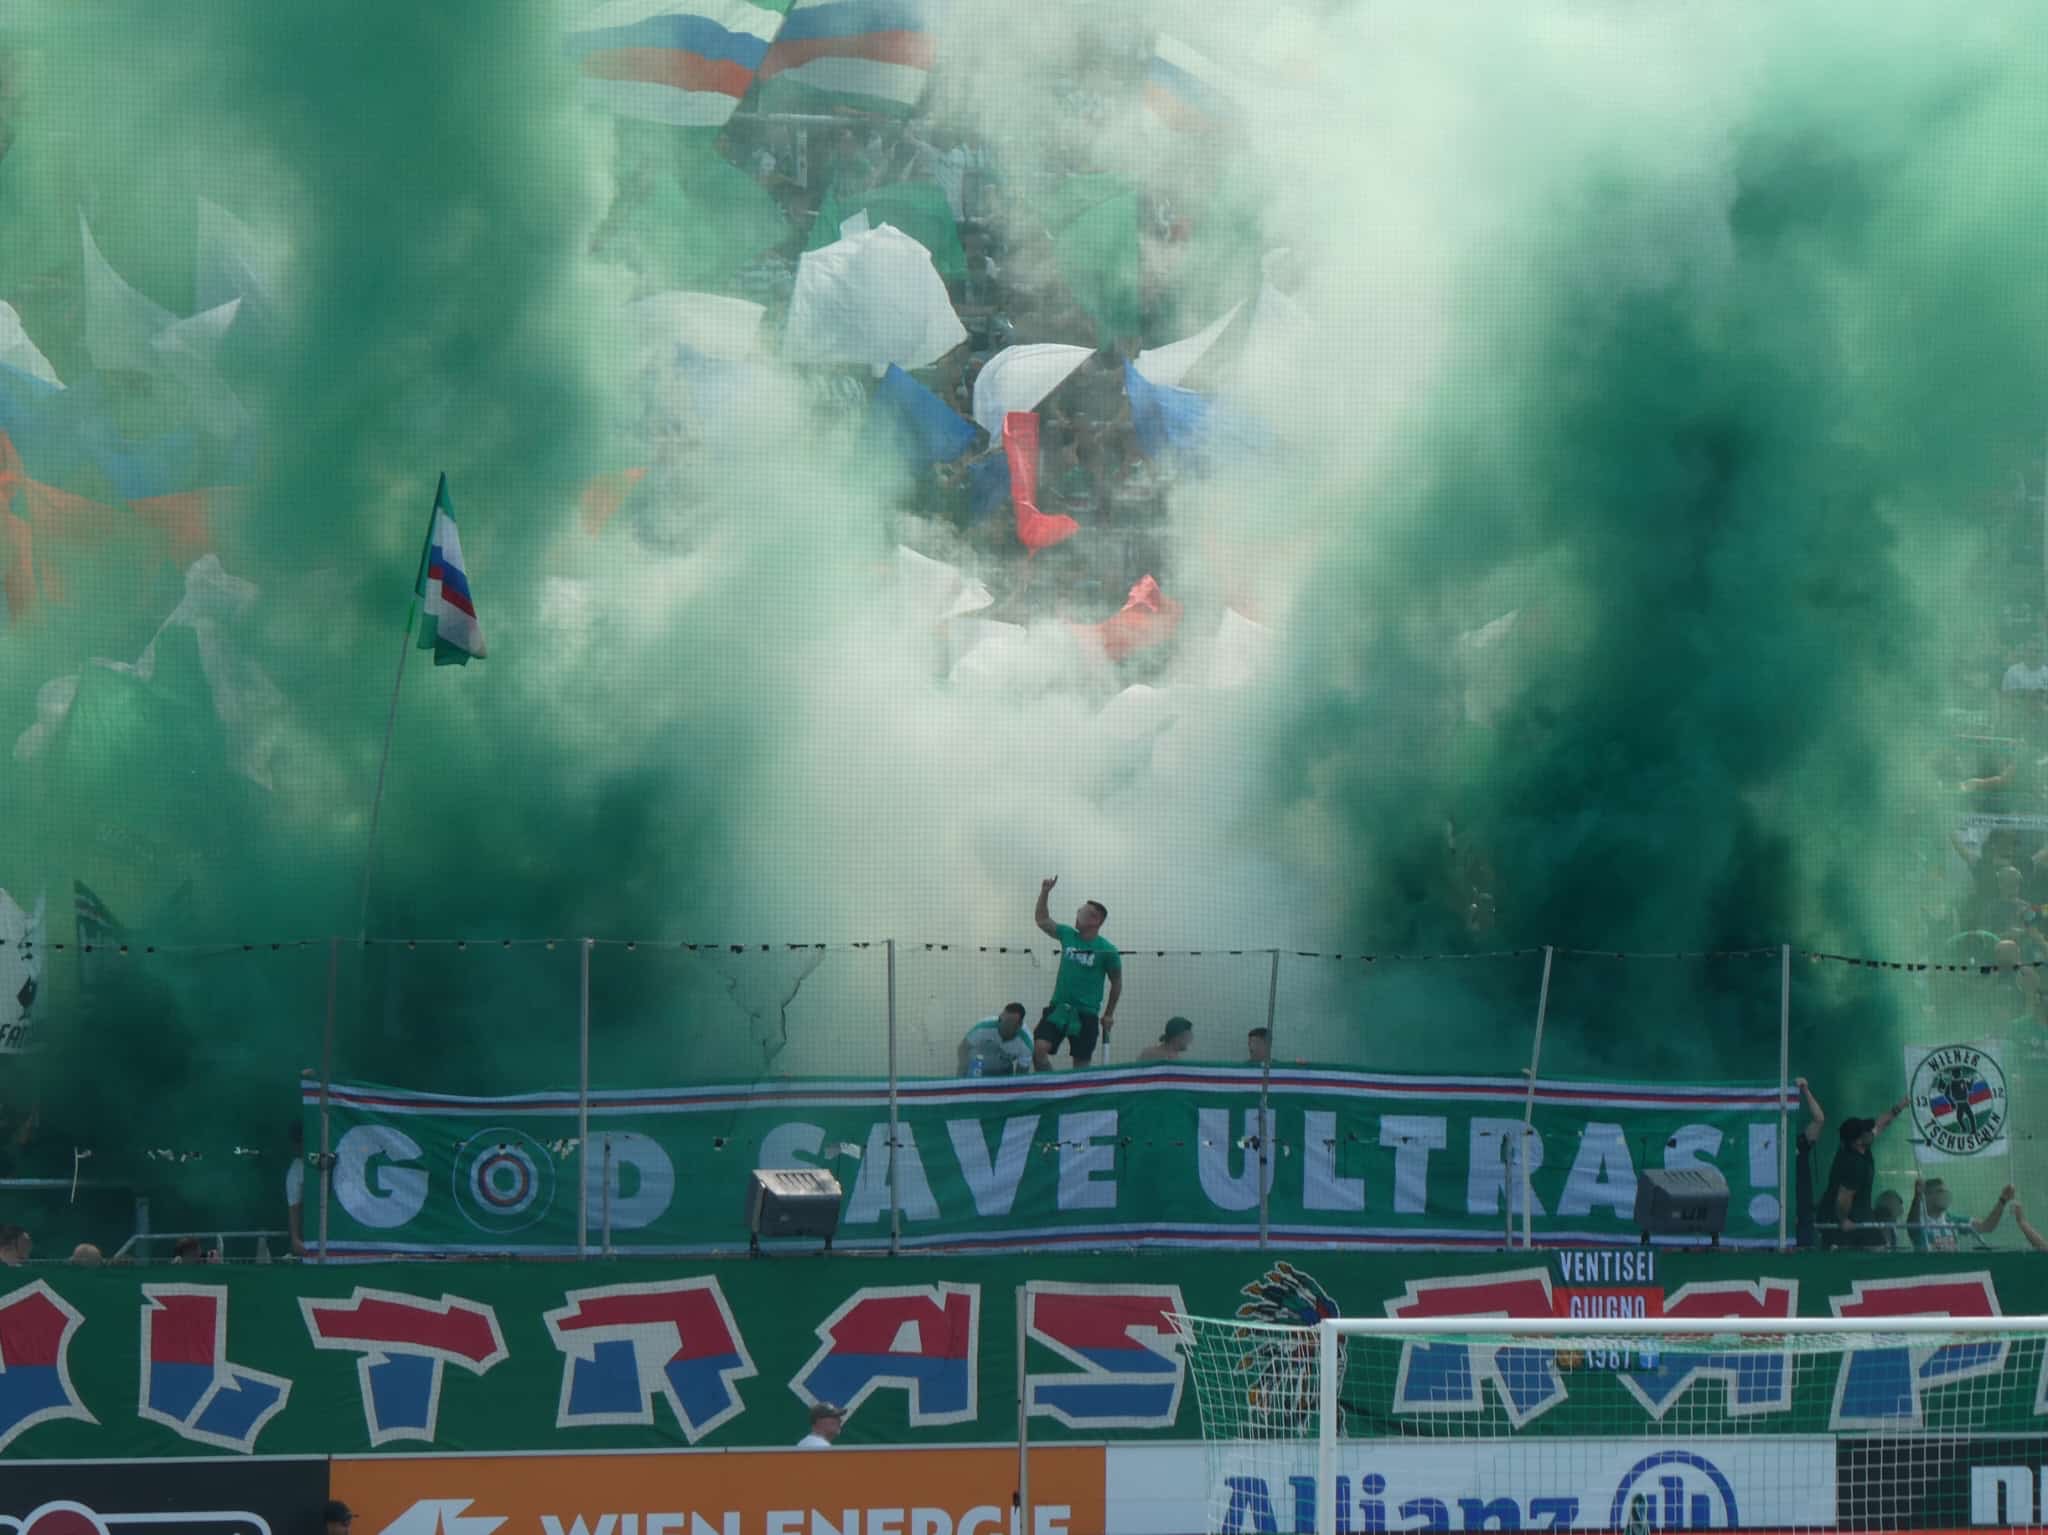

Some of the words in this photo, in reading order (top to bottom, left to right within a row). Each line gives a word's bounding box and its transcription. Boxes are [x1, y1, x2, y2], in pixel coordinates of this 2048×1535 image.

[1928, 1050, 1980, 1072] WIENER
[1198, 1108, 1779, 1226] ULTRAS!
[1560, 1252, 1654, 1281] VENTISEI
[1570, 1295, 1646, 1319] GIUGNO
[1384, 1267, 2048, 1431] RAP
[1222, 1473, 1579, 1532] Allianz
